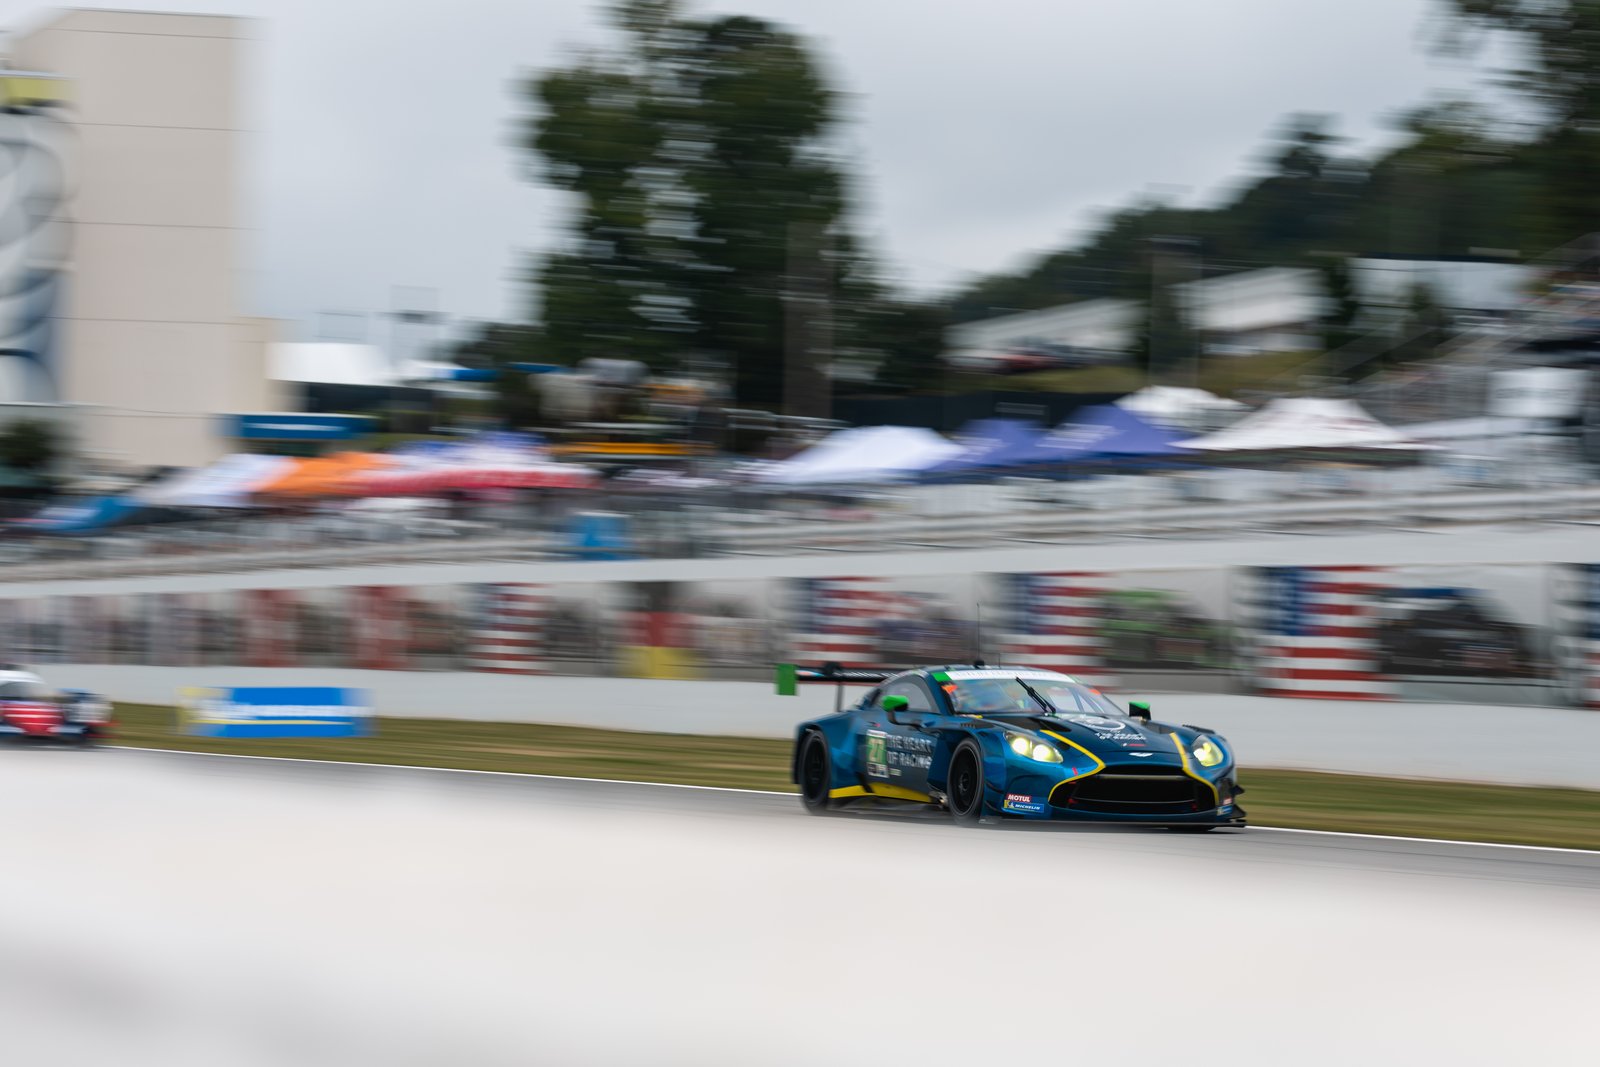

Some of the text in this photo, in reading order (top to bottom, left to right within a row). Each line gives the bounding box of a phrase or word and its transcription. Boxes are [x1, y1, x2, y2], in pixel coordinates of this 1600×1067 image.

[903, 736, 933, 753] HEART
[900, 752, 932, 769] RACING
[1007, 794, 1031, 803] MOTUL
[1015, 803, 1041, 811] MICHELIN
